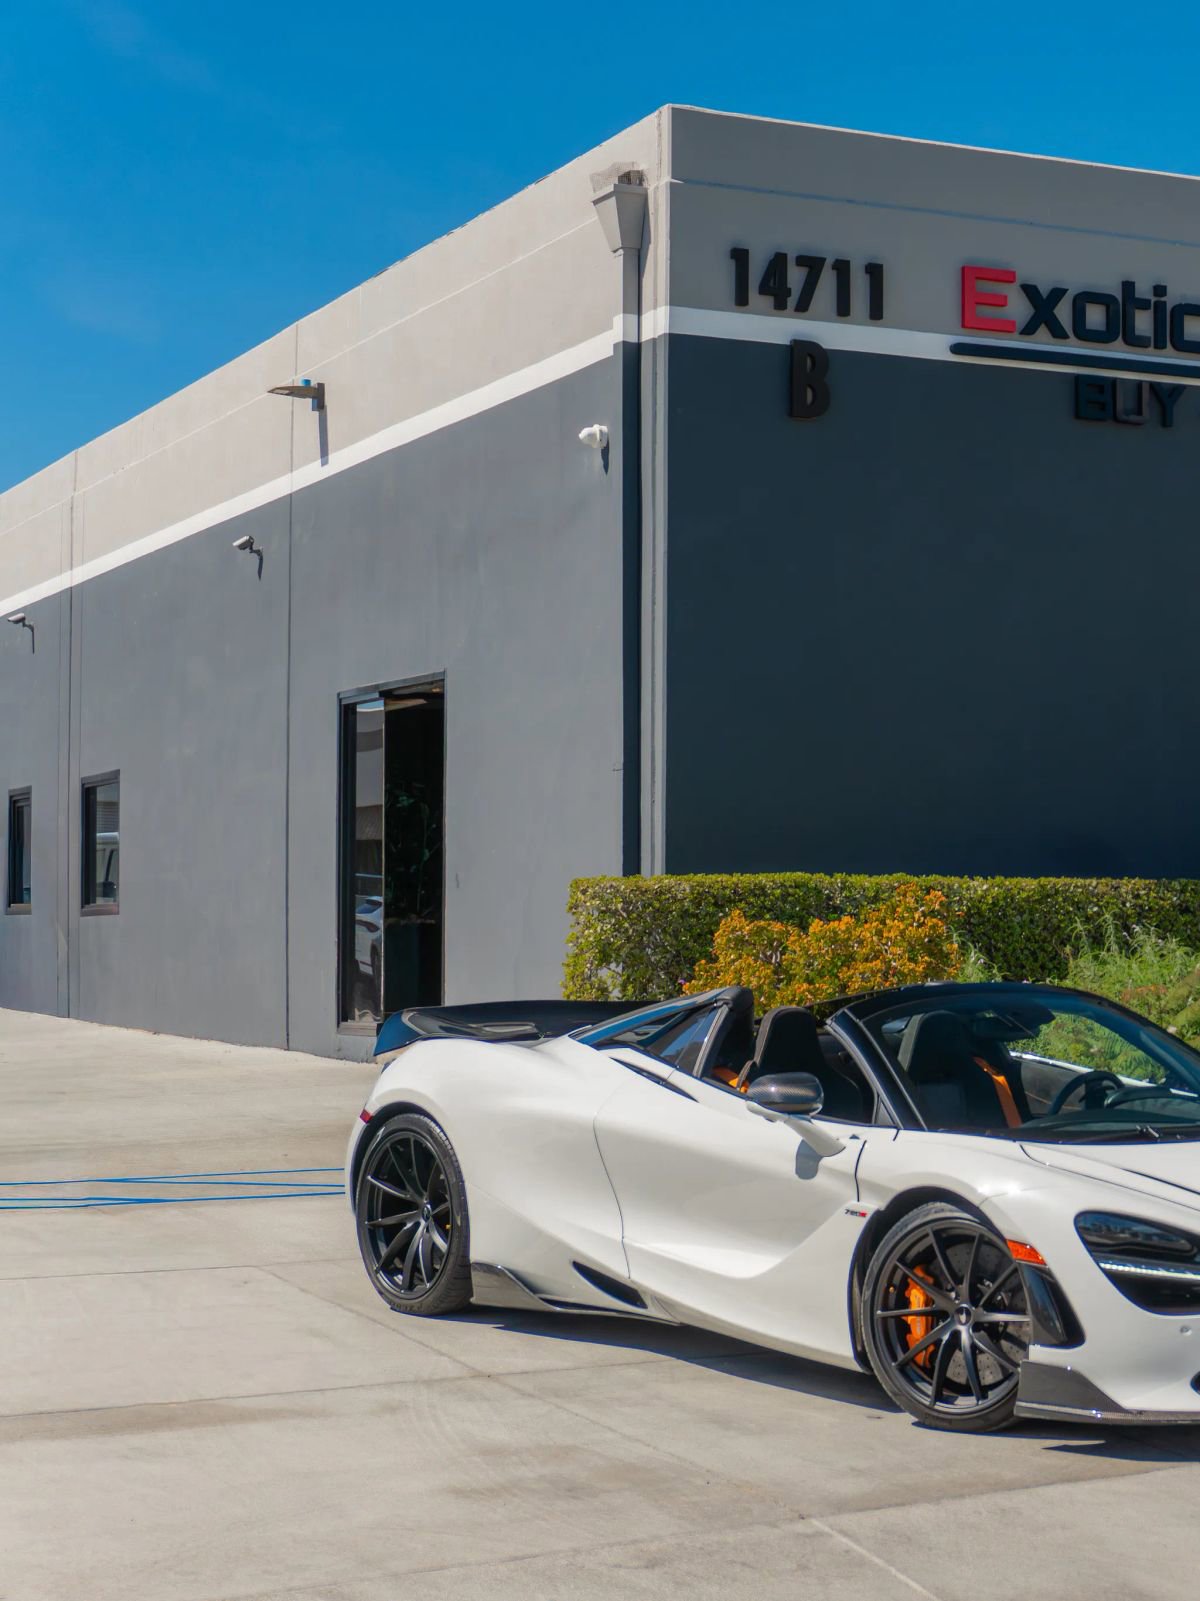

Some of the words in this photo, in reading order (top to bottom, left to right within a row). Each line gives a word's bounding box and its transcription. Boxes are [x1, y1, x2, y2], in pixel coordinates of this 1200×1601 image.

[730, 247, 884, 320] 14711
[789, 339, 831, 419] B
[1074, 374, 1185, 428] BUY
